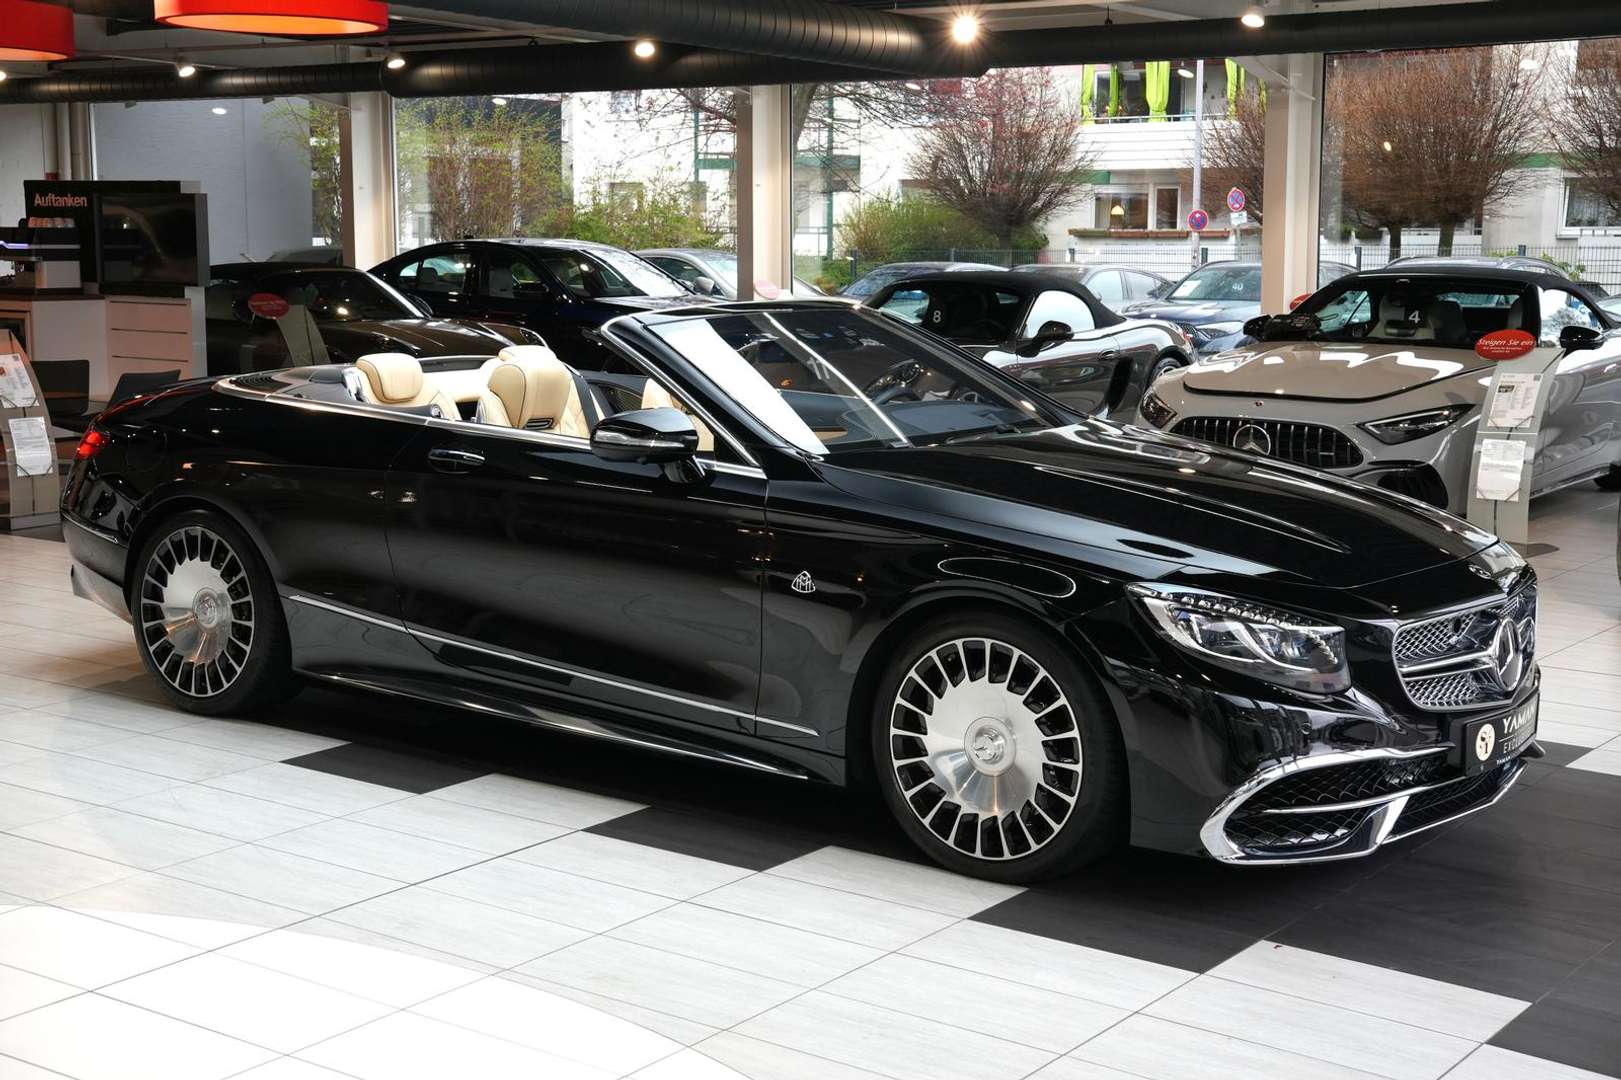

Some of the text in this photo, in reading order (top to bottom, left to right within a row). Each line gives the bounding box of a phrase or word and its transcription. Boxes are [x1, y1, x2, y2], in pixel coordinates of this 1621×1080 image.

[34, 192, 88, 207] Auftanken
[932, 310, 942, 323] 8
[1408, 310, 1421, 324] 4
[1477, 338, 1506, 347] Steigen
[1507, 338, 1520, 346] Sie
